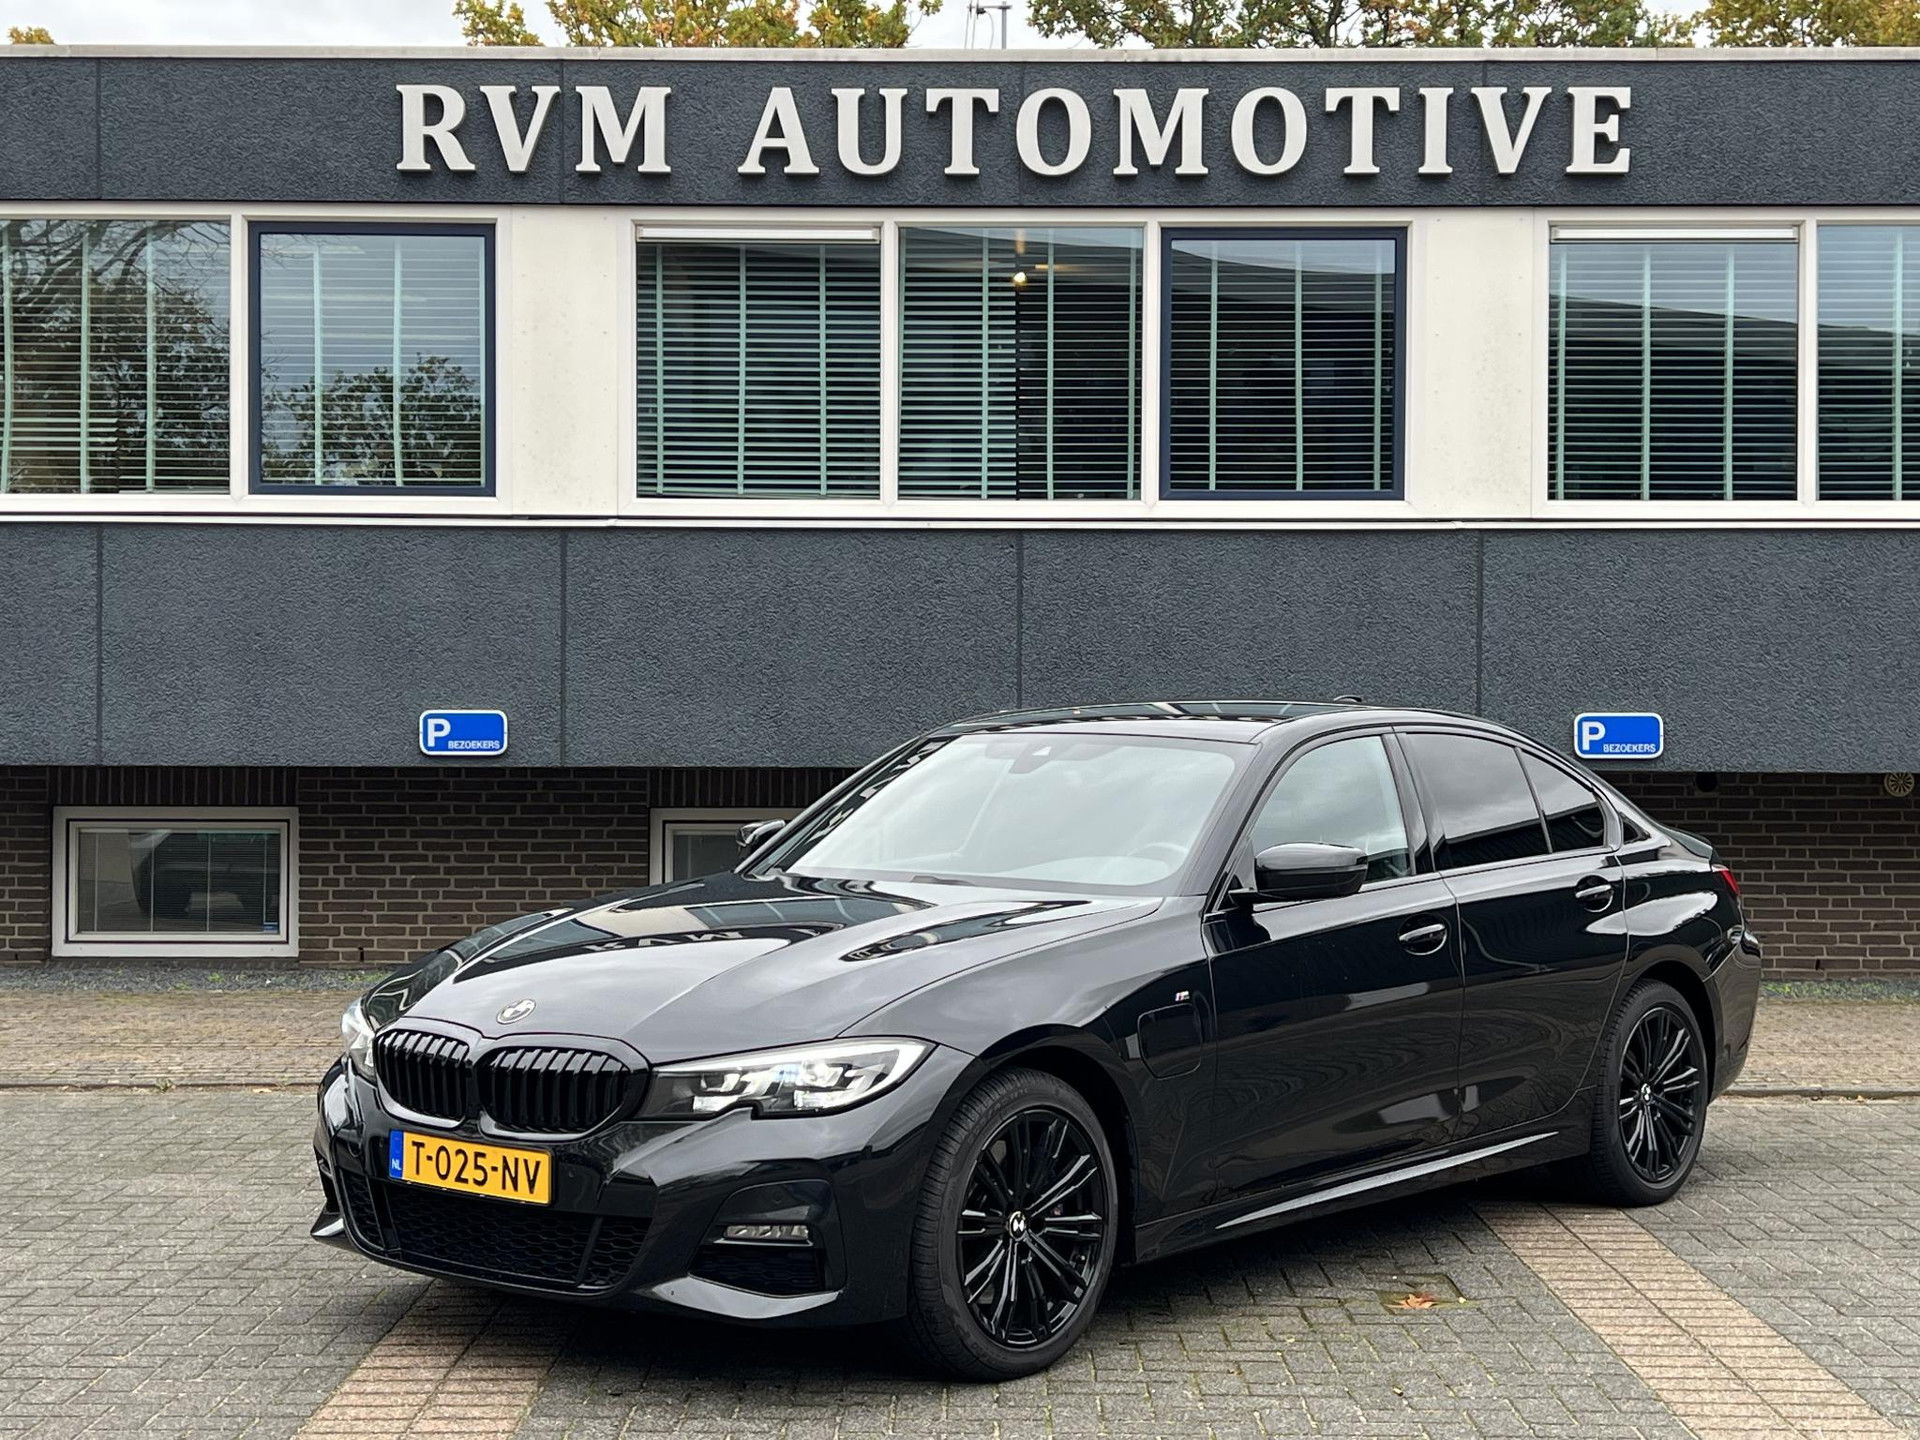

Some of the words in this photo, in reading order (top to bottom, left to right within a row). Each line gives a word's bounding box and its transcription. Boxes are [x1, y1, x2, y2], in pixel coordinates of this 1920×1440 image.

[396, 84, 672, 173] RVM
[737, 86, 1632, 176] AUTOMOTIVE
[427, 718, 451, 747] P
[448, 740, 500, 749] BEZOEKERS
[1582, 721, 1606, 750] P
[1603, 743, 1656, 753] BEZOEKERS
[391, 1158, 402, 1170] NL
[411, 1140, 541, 1194] T-025-NV
